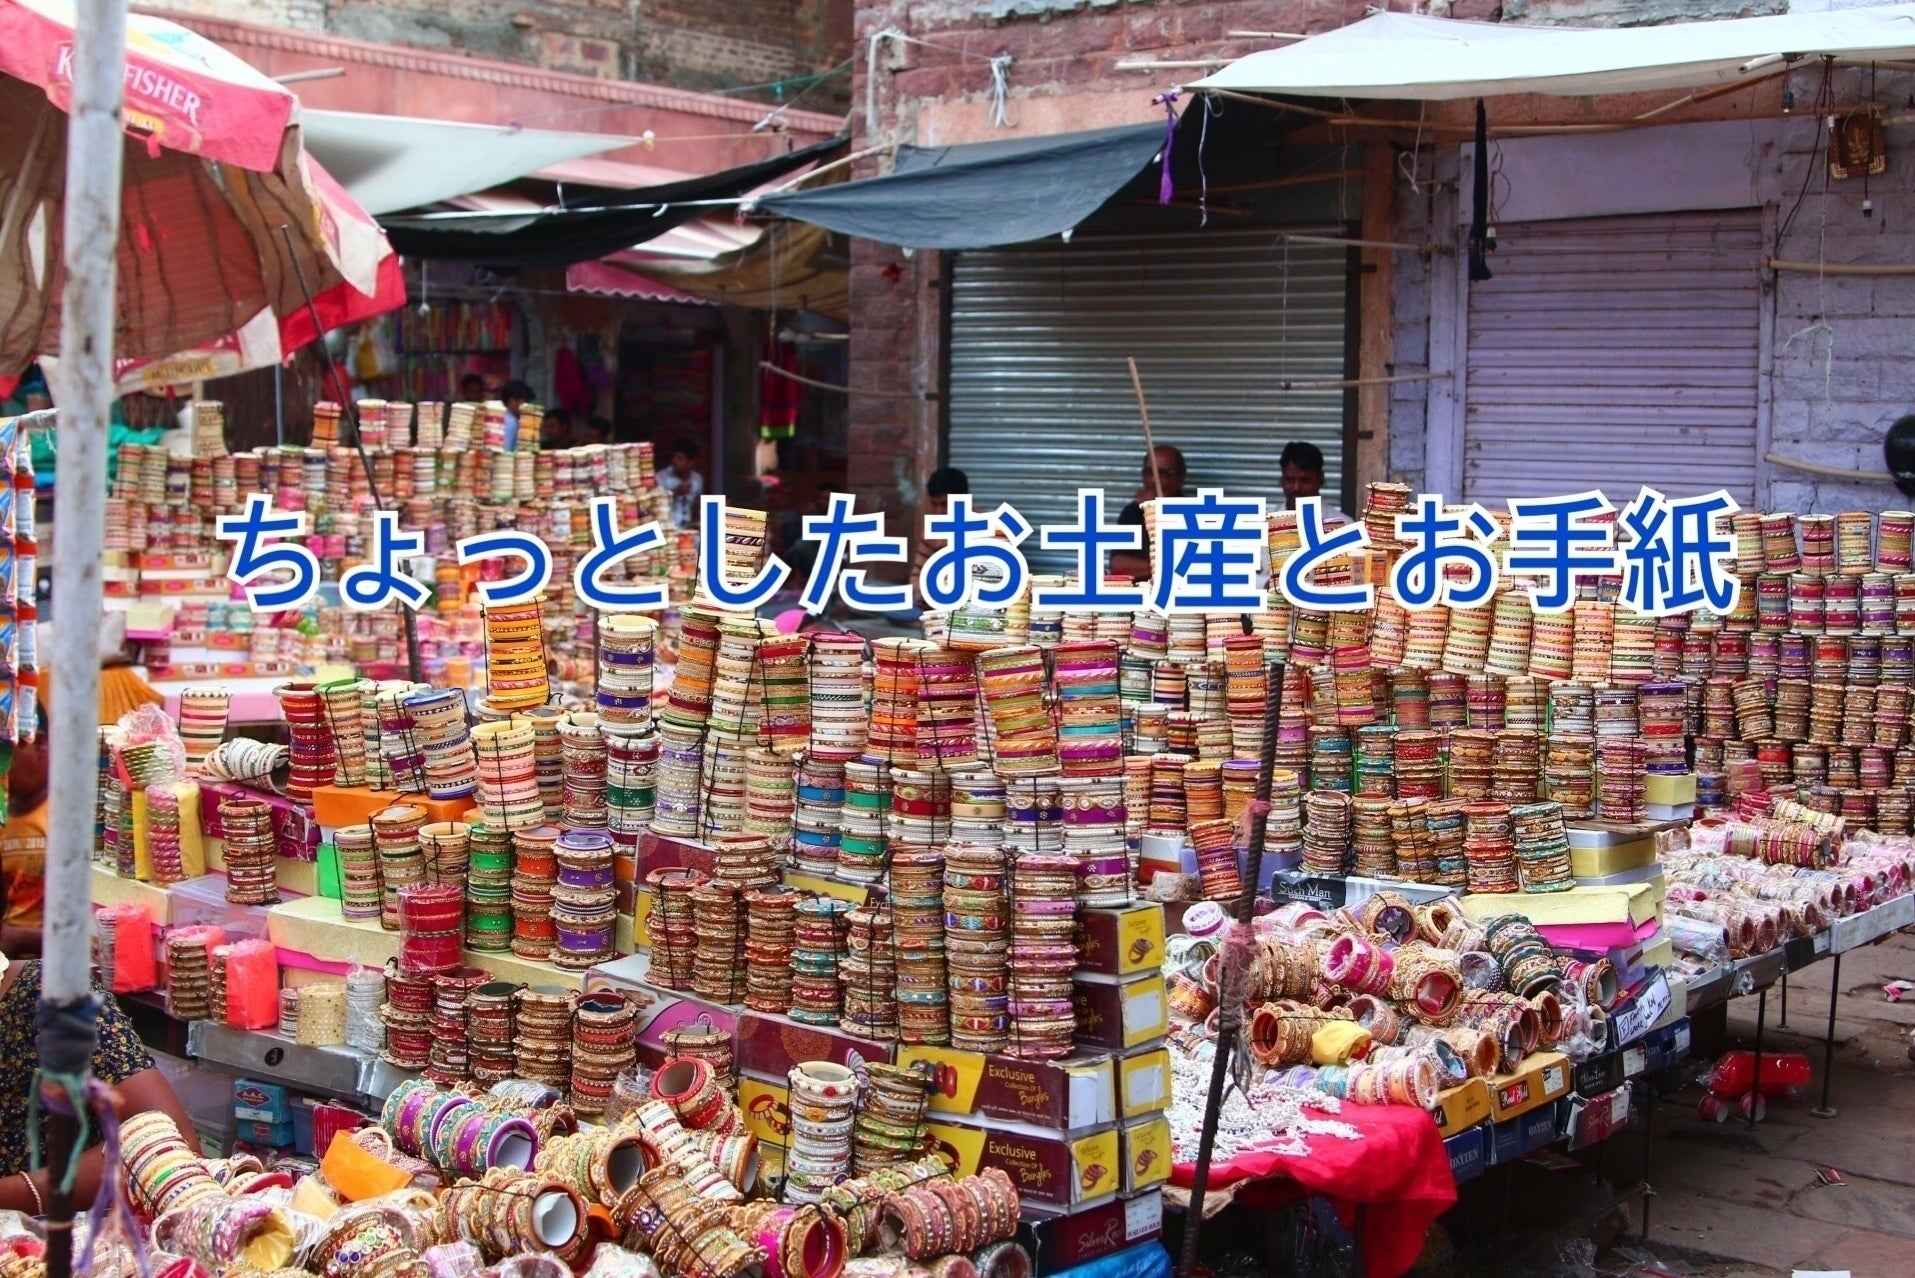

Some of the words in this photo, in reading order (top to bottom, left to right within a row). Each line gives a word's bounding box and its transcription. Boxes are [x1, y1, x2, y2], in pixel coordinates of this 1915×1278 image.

[56, 46, 201, 126] KFISHER
[1307, 883, 1331, 898] Man
[988, 1064, 1036, 1083] Exclusive
[1004, 1081, 1029, 1091] Collection
[1019, 1085, 1050, 1110] Bangles
[988, 1141, 1037, 1161] Exclusive
[1005, 1158, 1030, 1168] Collection
[1020, 1162, 1052, 1187] Bangles
